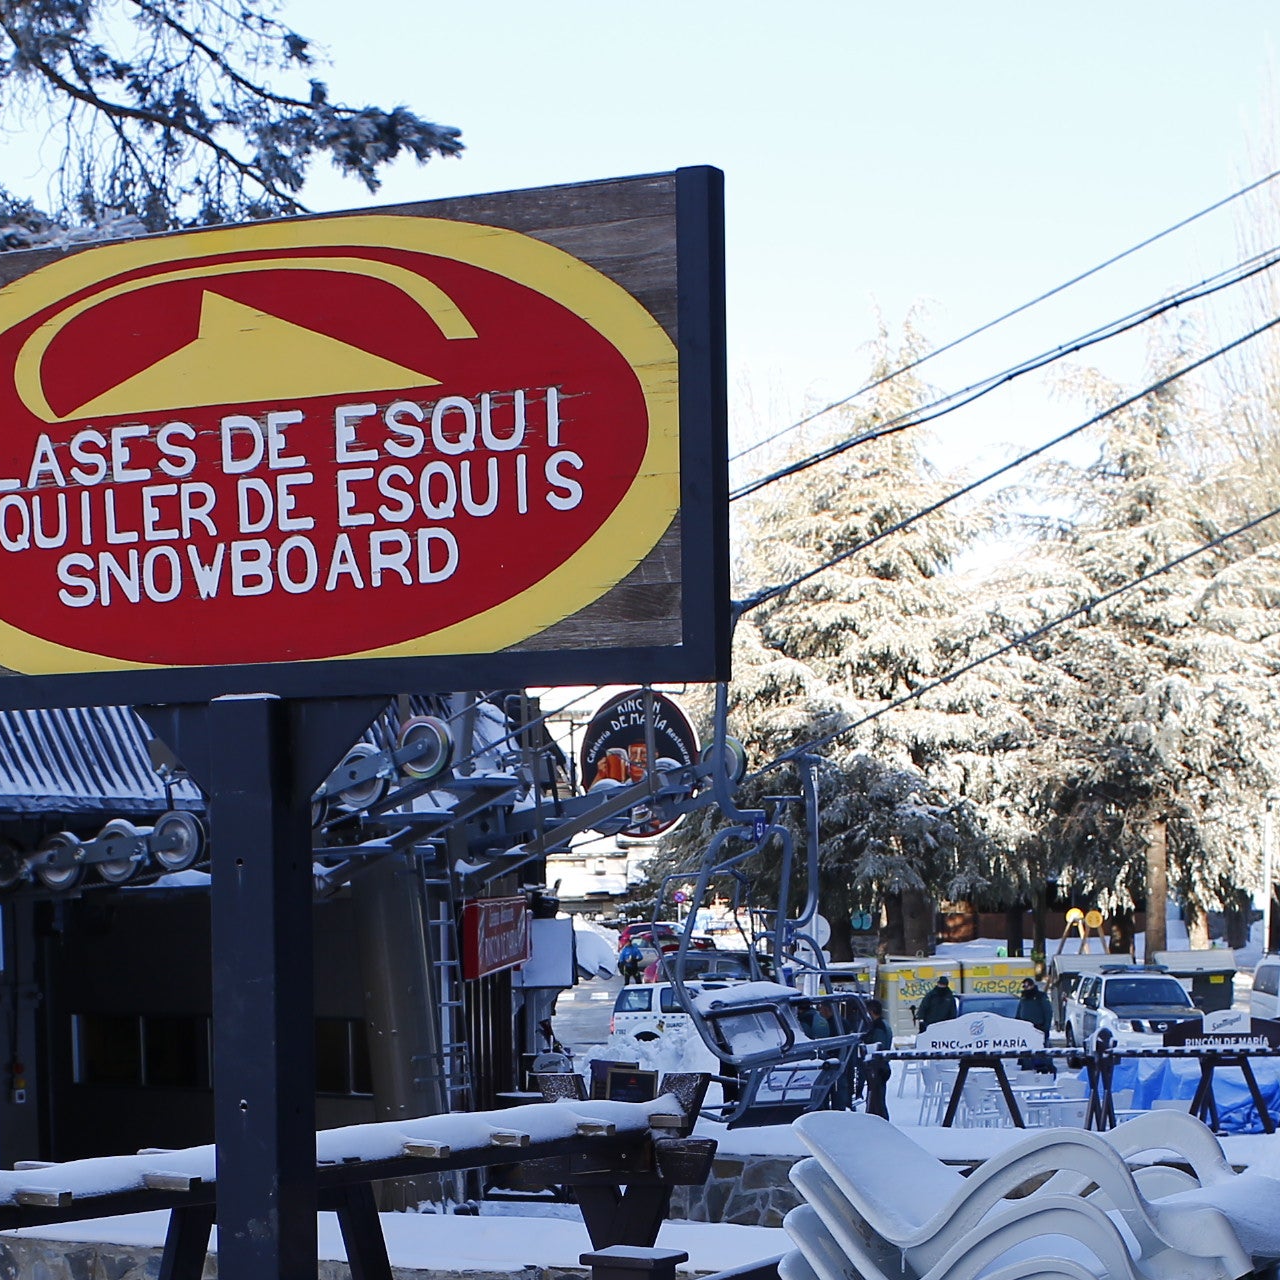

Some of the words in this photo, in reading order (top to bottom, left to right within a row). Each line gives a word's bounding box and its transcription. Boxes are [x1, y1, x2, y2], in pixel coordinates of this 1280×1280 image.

[222, 410, 306, 475] DE
[335, 386, 561, 464] ESQUI
[237, 473, 314, 534] DE
[337, 451, 584, 528] ESQUIS
[57, 526, 459, 607] SNOWBOARD
[617, 699, 661, 713] RINCN
[611, 716, 629, 731] DE
[630, 712, 667, 730] MAÍA
[666, 727, 692, 765] Restauran
[993, 1037, 1027, 1048] MARÍA
[1185, 1035, 1222, 1046] RINCÓN
[1224, 1037, 1237, 1045] DE
[1239, 1034, 1269, 1046] MARÍA
